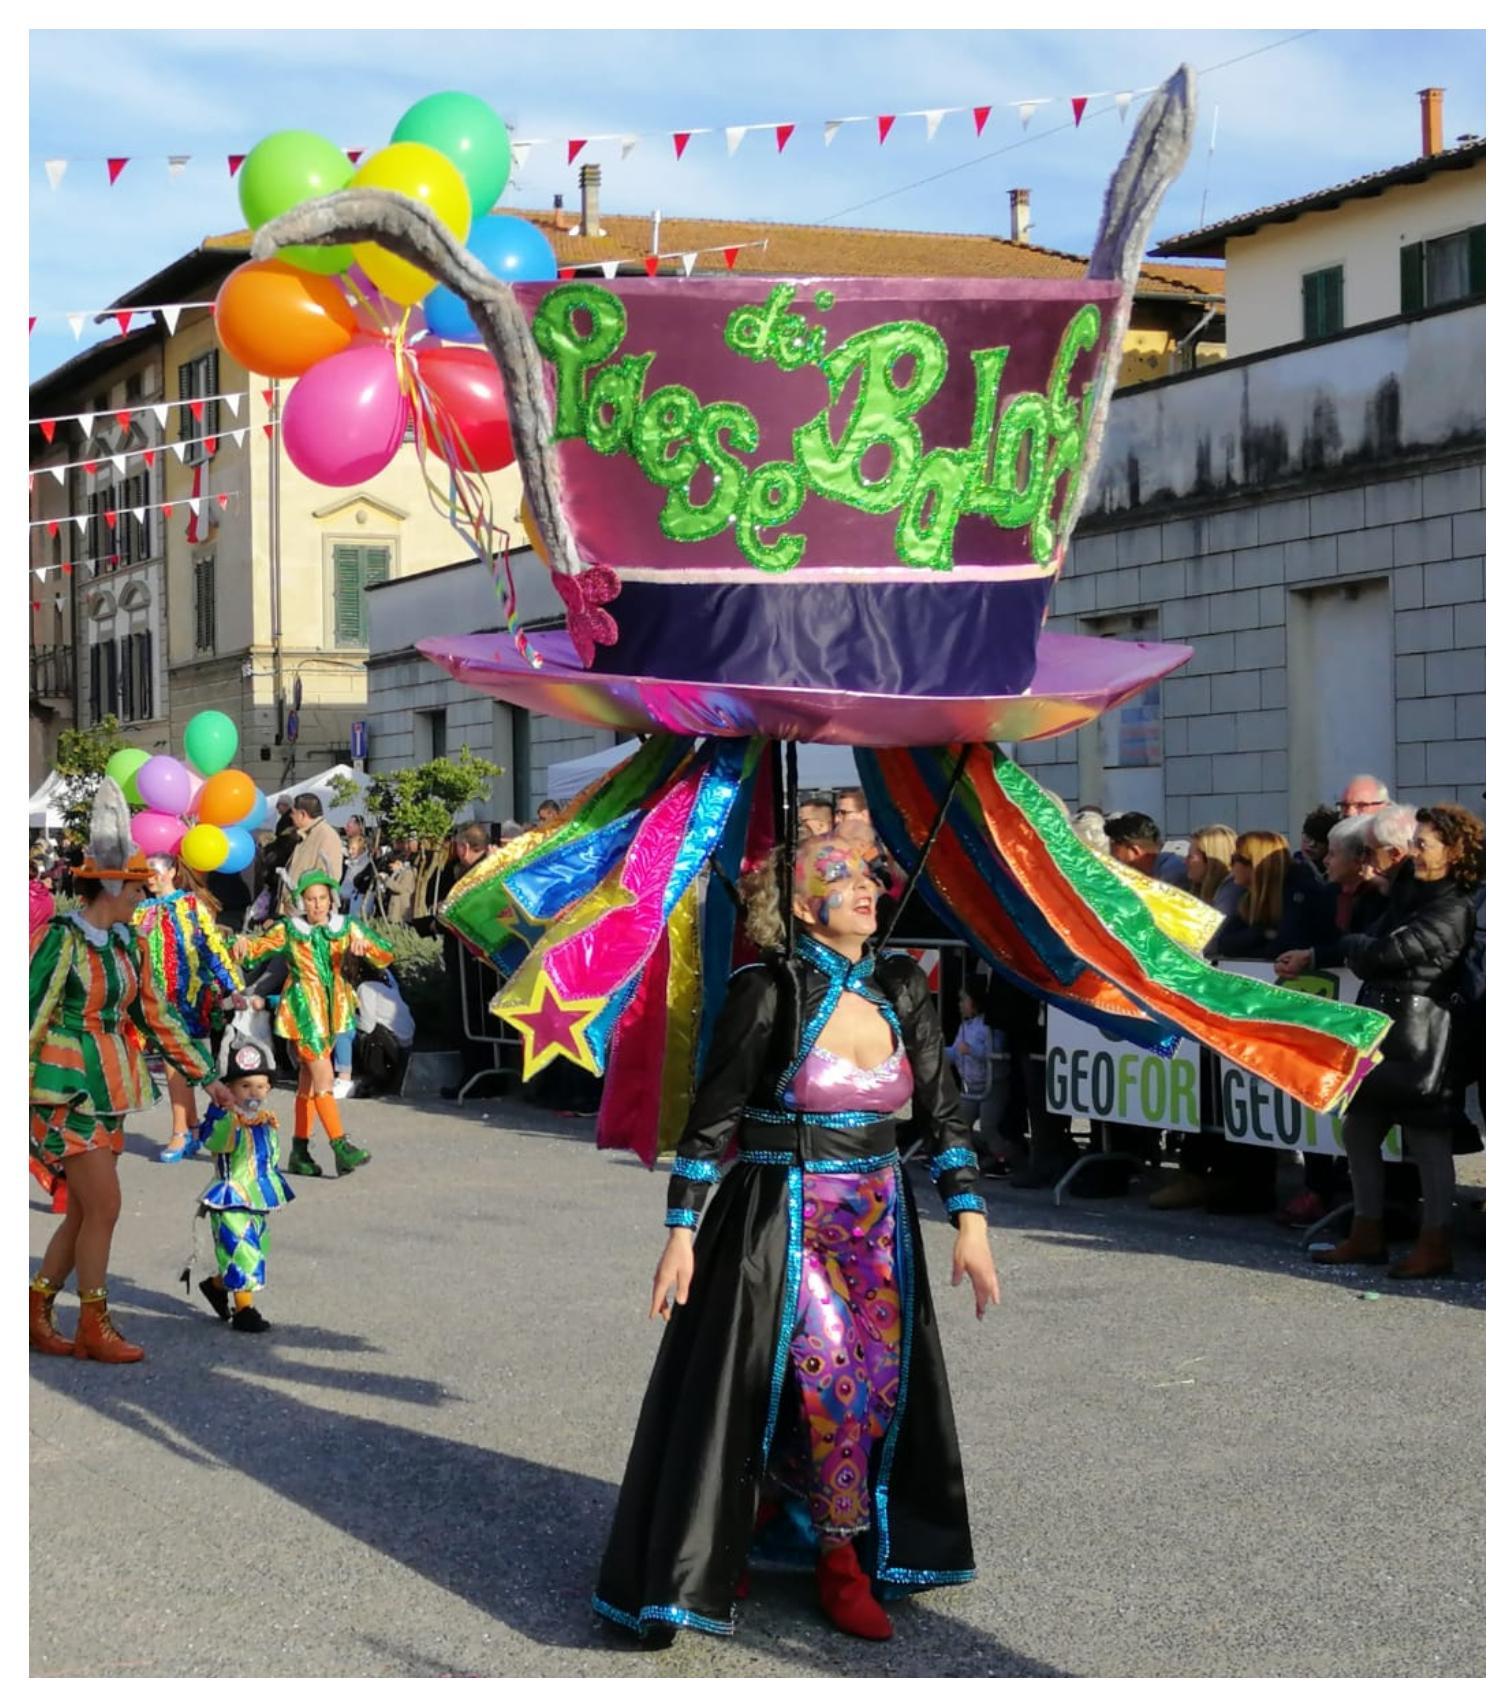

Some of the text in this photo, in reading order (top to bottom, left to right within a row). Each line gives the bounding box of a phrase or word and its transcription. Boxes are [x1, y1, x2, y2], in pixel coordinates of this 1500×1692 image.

[725, 282, 836, 371] dei
[531, 281, 807, 573] Paese
[1046, 1046, 1201, 1129] GEOFOR
